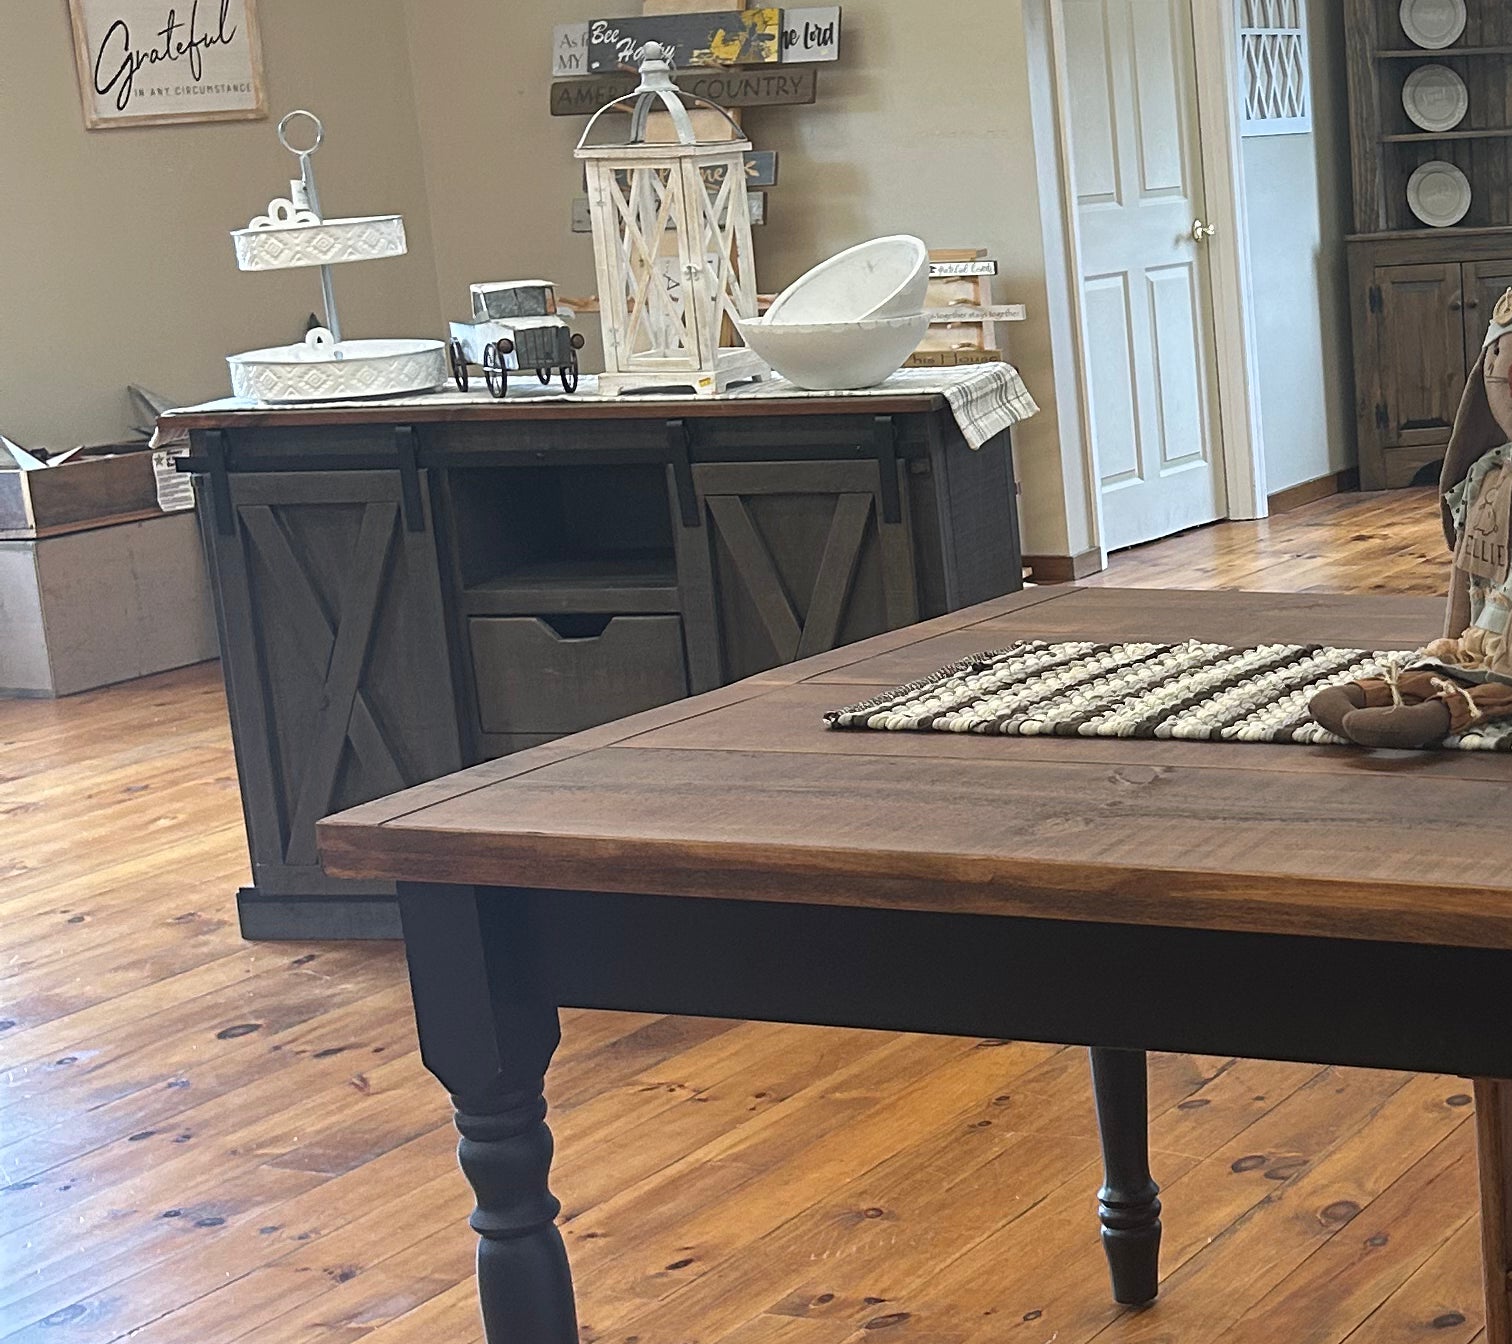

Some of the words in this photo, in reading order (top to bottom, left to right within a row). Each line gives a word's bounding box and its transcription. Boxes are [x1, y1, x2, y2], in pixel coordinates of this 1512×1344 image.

[560, 33, 578, 49] As
[591, 20, 620, 45] Bee
[559, 53, 584, 70] MY
[616, 36, 675, 66] Hay
[134, 88, 145, 97] IN
[150, 86, 170, 96] ANY
[174, 82, 252, 96] CIRCUMSTANCE
[557, 85, 618, 107] AMER
[694, 75, 803, 100] COUNTRY
[913, 353, 935, 364] his
[1465, 535, 1505, 567] ELLIE
